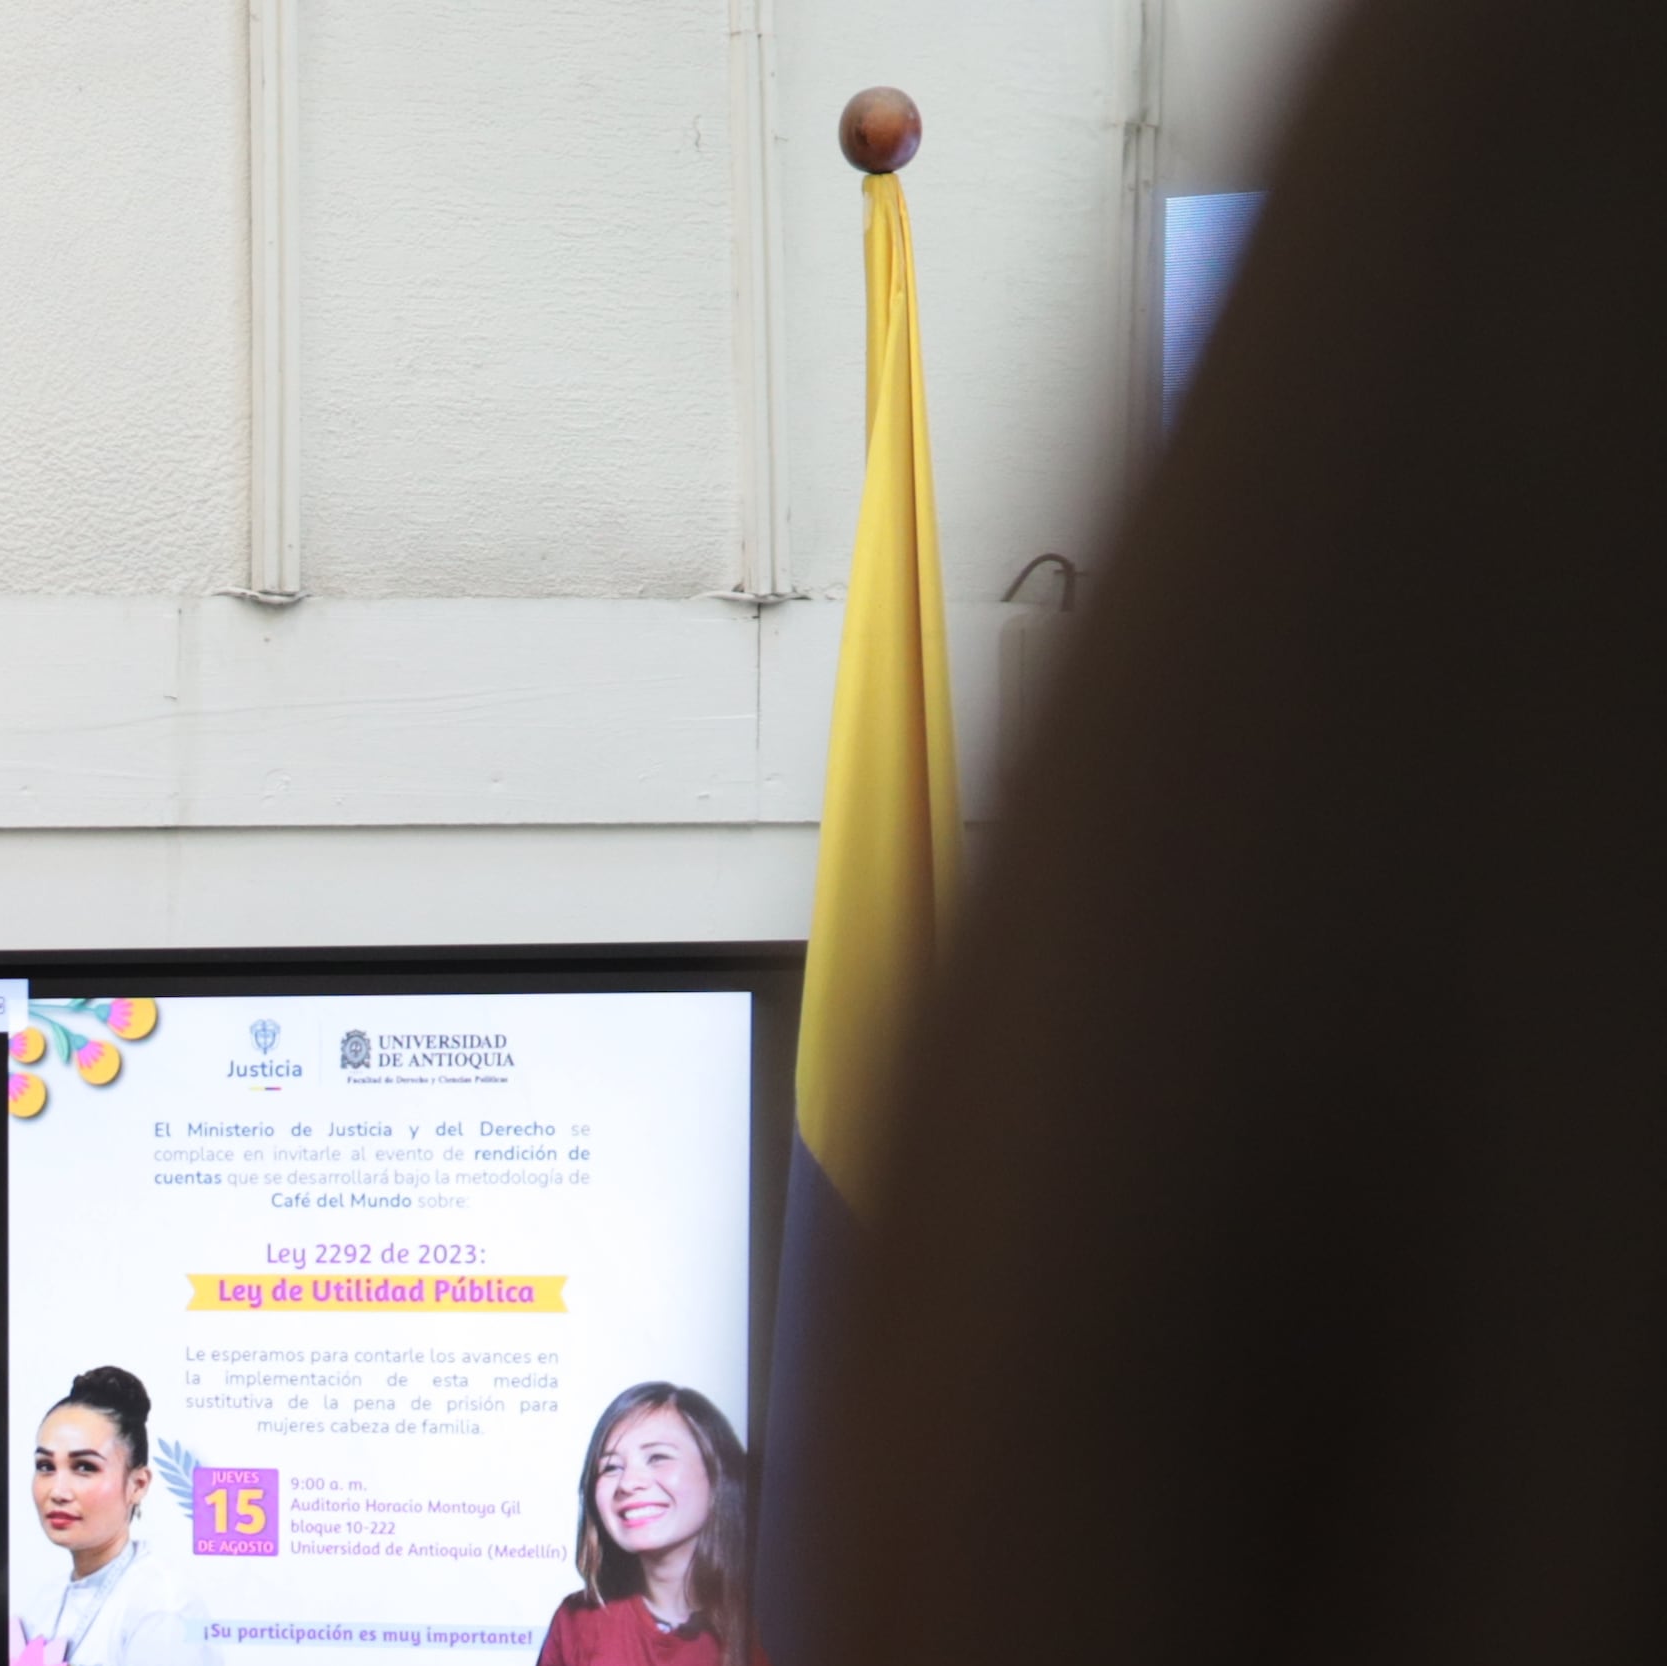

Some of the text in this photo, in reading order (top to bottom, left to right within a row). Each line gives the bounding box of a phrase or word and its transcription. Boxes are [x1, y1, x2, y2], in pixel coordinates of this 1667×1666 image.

[227, 1034, 508, 1078] Justicia UNIVERSIDAD
[378, 1052, 515, 1070] DE ANTIOQUIA
[154, 1121, 591, 1141] El Ministerio de Justicia y del Derecho se
[153, 1144, 591, 1165] complace en invitarle al evento de rendición de
[154, 1168, 591, 1189] cuentas que se desarrollará bajo la metodología de
[271, 1192, 311, 1209] Café
[316, 1192, 345, 1208] del
[350, 1192, 412, 1208] Mundo
[266, 1242, 487, 1270] Ley 2292 de 2023:
[218, 1276, 535, 1309] Ley de Utilidad Pública
[186, 1346, 559, 1365] Le esperamos para contarle los avances en
[185, 1370, 559, 1389] la implementación de esta medida
[185, 1393, 559, 1415] sustitutiva de la pena de prisión para
[257, 1418, 485, 1436] mujeres cabeza de familia.
[211, 1471, 260, 1485] JUEVES
[290, 1477, 368, 1492] 9:00 a. m.
[204, 1488, 267, 1535] 15
[290, 1498, 521, 1519] Auditorio Horacio Montoya Gil
[290, 1520, 396, 1537] bloque 10-222
[198, 1540, 274, 1554] DE AGOSTO
[290, 1541, 568, 1562] Universidad de Antioquia (Medellín)
[204, 1622, 533, 1648] ¡Su participación es muy importante!
